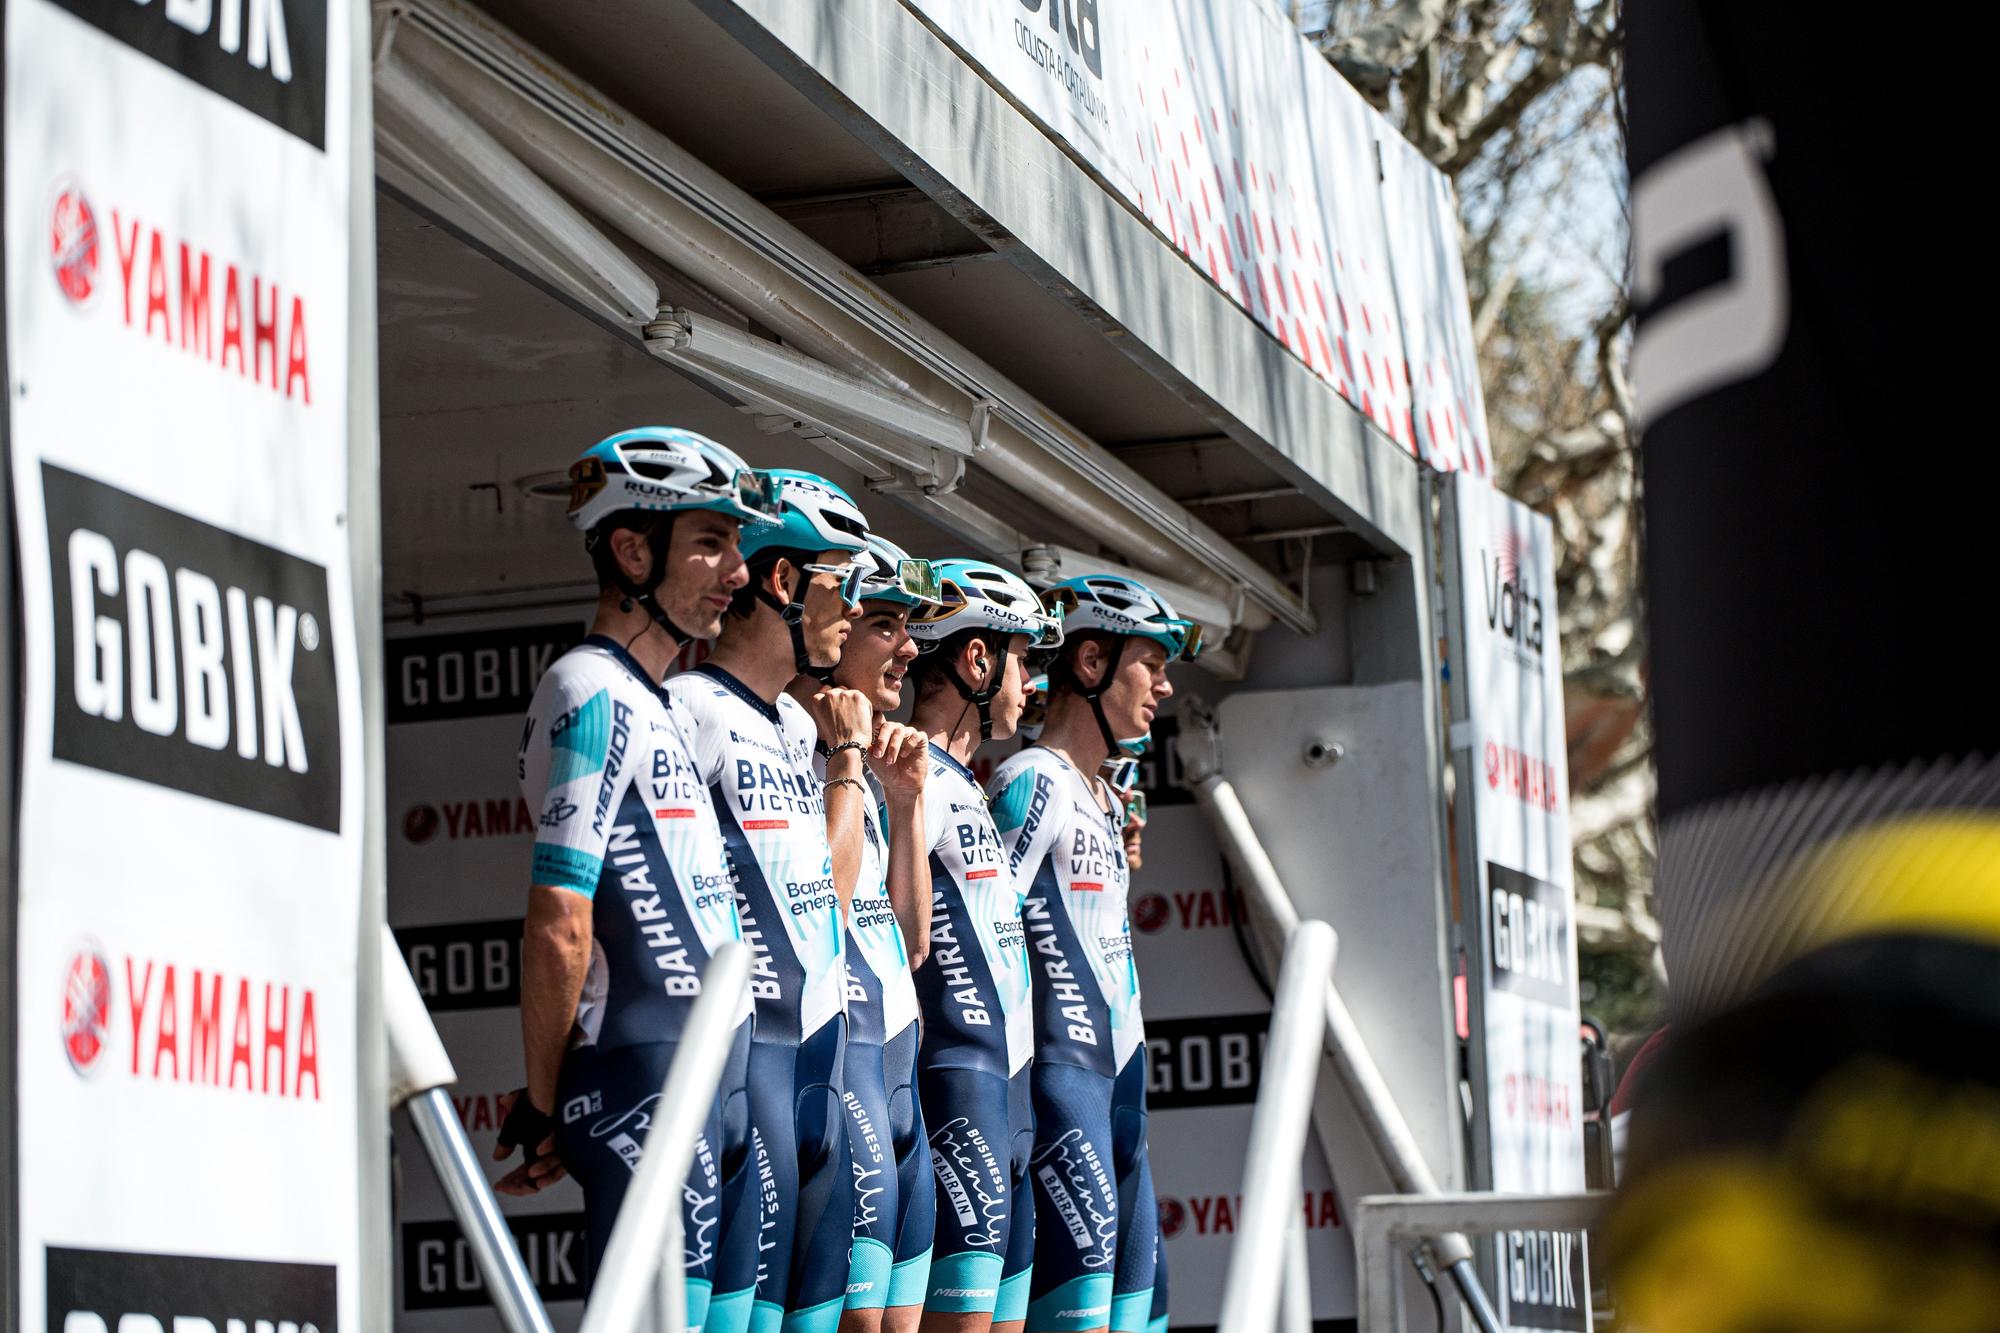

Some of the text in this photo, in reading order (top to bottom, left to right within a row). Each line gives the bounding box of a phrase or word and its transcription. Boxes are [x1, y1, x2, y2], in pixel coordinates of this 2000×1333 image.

[1014, 17, 1057, 80] CICLISTA
[1057, 53, 1065, 87] A
[112, 208, 311, 407] YAMAHA
[624, 481, 688, 500] RUDY
[982, 604, 1028, 625] RUDY
[1092, 606, 1141, 627] RUDY
[592, 699, 634, 839] MERIDA
[1009, 772, 1054, 878] MERIDA
[607, 823, 702, 997] BAHRAIN
[1492, 887, 1562, 986] GOBIK
[409, 939, 524, 997] GOB
[1023, 897, 1098, 1046] BAHRAIN
[125, 954, 321, 1102] YAMAHA
[842, 1091, 884, 1164] BUSINESS
[966, 1128, 1006, 1194] BUSINESS
[931, 1156, 972, 1216] BAHRAIN
[1044, 1175, 1087, 1238] BAHRAIN
[1079, 1141, 1117, 1212] BUSINESS
[418, 1231, 577, 1293] GOIK
[932, 1288, 996, 1298] MERIDA
